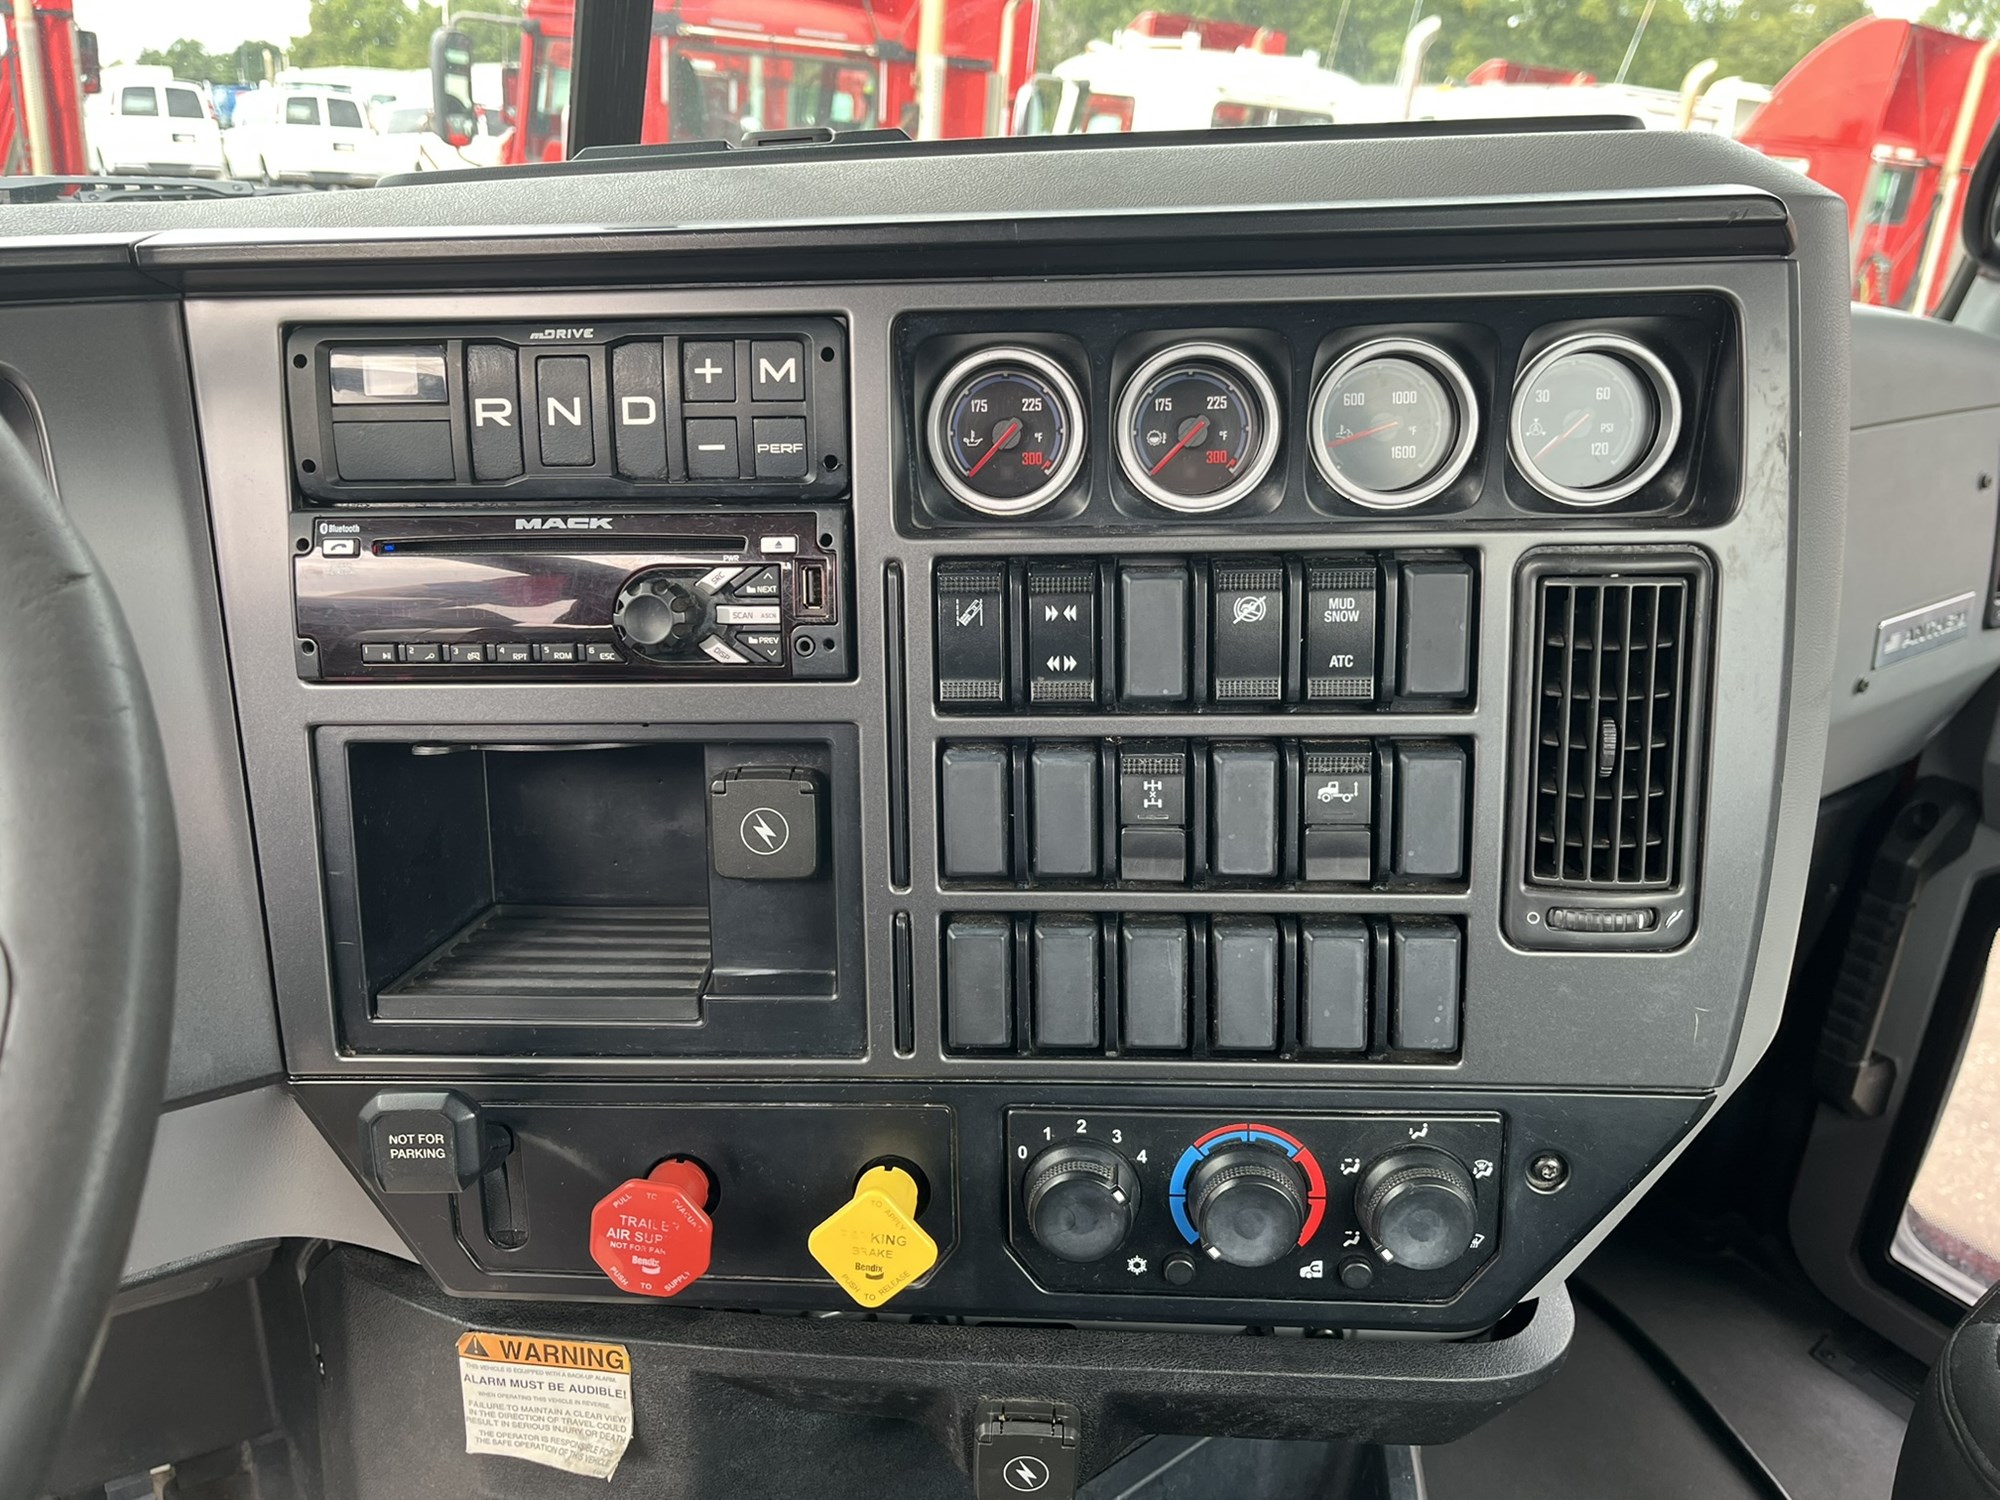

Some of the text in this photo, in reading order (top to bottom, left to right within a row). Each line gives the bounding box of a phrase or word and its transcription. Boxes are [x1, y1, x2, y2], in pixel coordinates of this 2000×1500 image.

[529, 328, 594, 340] mDRIVE
[759, 357, 796, 384] M
[1343, 390, 1417, 406] 600 1000
[1535, 387, 1611, 403] 30 60
[547, 396, 582, 426] N
[621, 395, 656, 426] D
[970, 397, 1042, 413] 175 225
[1154, 396, 1227, 412] 175 225
[474, 397, 512, 427] R
[1600, 423, 1614, 433] PSI
[757, 443, 803, 454] PERF
[1391, 445, 1416, 459] 1600
[1591, 442, 1609, 456] 120
[1022, 452, 1042, 465] 300
[1206, 450, 1227, 464] 300
[329, 524, 360, 533] Bluetooth
[515, 517, 613, 530] MACK
[723, 554, 739, 562] PWR
[711, 571, 726, 585] SRC
[756, 585, 777, 593] NEXT
[1328, 597, 1355, 610] MUD
[732, 611, 753, 620] SCAN
[1324, 610, 1360, 623] SNOW
[409, 646, 415, 654] 2
[453, 647, 459, 655] 3
[544, 646, 550, 654] 5
[588, 646, 595, 654] 6
[600, 652, 615, 660] ESC
[1329, 654, 1353, 668] ATC
[1076, 1119, 1087, 1134] 2
[388, 1133, 445, 1145] NOT FOR
[1043, 1127, 1052, 1141] 1
[1112, 1129, 1123, 1144] 3
[390, 1148, 446, 1159] PARKING
[1017, 1146, 1028, 1160] 0
[1136, 1150, 1148, 1164] 4
[612, 1193, 632, 1209] PULL
[871, 1200, 883, 1208] TO
[606, 1227, 630, 1240] AIR
[609, 1241, 628, 1250] NOT
[852, 1246, 893, 1259] BRAKE
[632, 1255, 660, 1267] Bendix
[855, 1261, 883, 1273] Bendix
[609, 1266, 629, 1286] PUSH
[640, 1282, 652, 1291] TO
[841, 1270, 911, 1301] PUSH TO RELEASE
[499, 1340, 624, 1370] WARNING
[464, 1373, 627, 1400] ALARM MUST BE AUDIBLE!
[468, 1399, 506, 1411] FAILURE
[506, 1404, 519, 1412] TO
[520, 1405, 563, 1415] MAINTAIN
[573, 1410, 603, 1420] CLEAR
[604, 1414, 627, 1423] VIEW
[468, 1408, 627, 1433] IN THE DIRECTION OF TRAVEL COULD
[466, 1416, 499, 1427] RESULT
[511, 1421, 551, 1432] SERIOUS
[552, 1425, 583, 1435] INJURY
[585, 1429, 598, 1437] OR
[599, 1431, 627, 1444] DEATH
[479, 1430, 495, 1438] THE
[496, 1431, 540, 1442] OPERATOR
[474, 1436, 491, 1445] THE
[492, 1438, 513, 1447] SAFE
[513, 1440, 558, 1454] OPERATION
